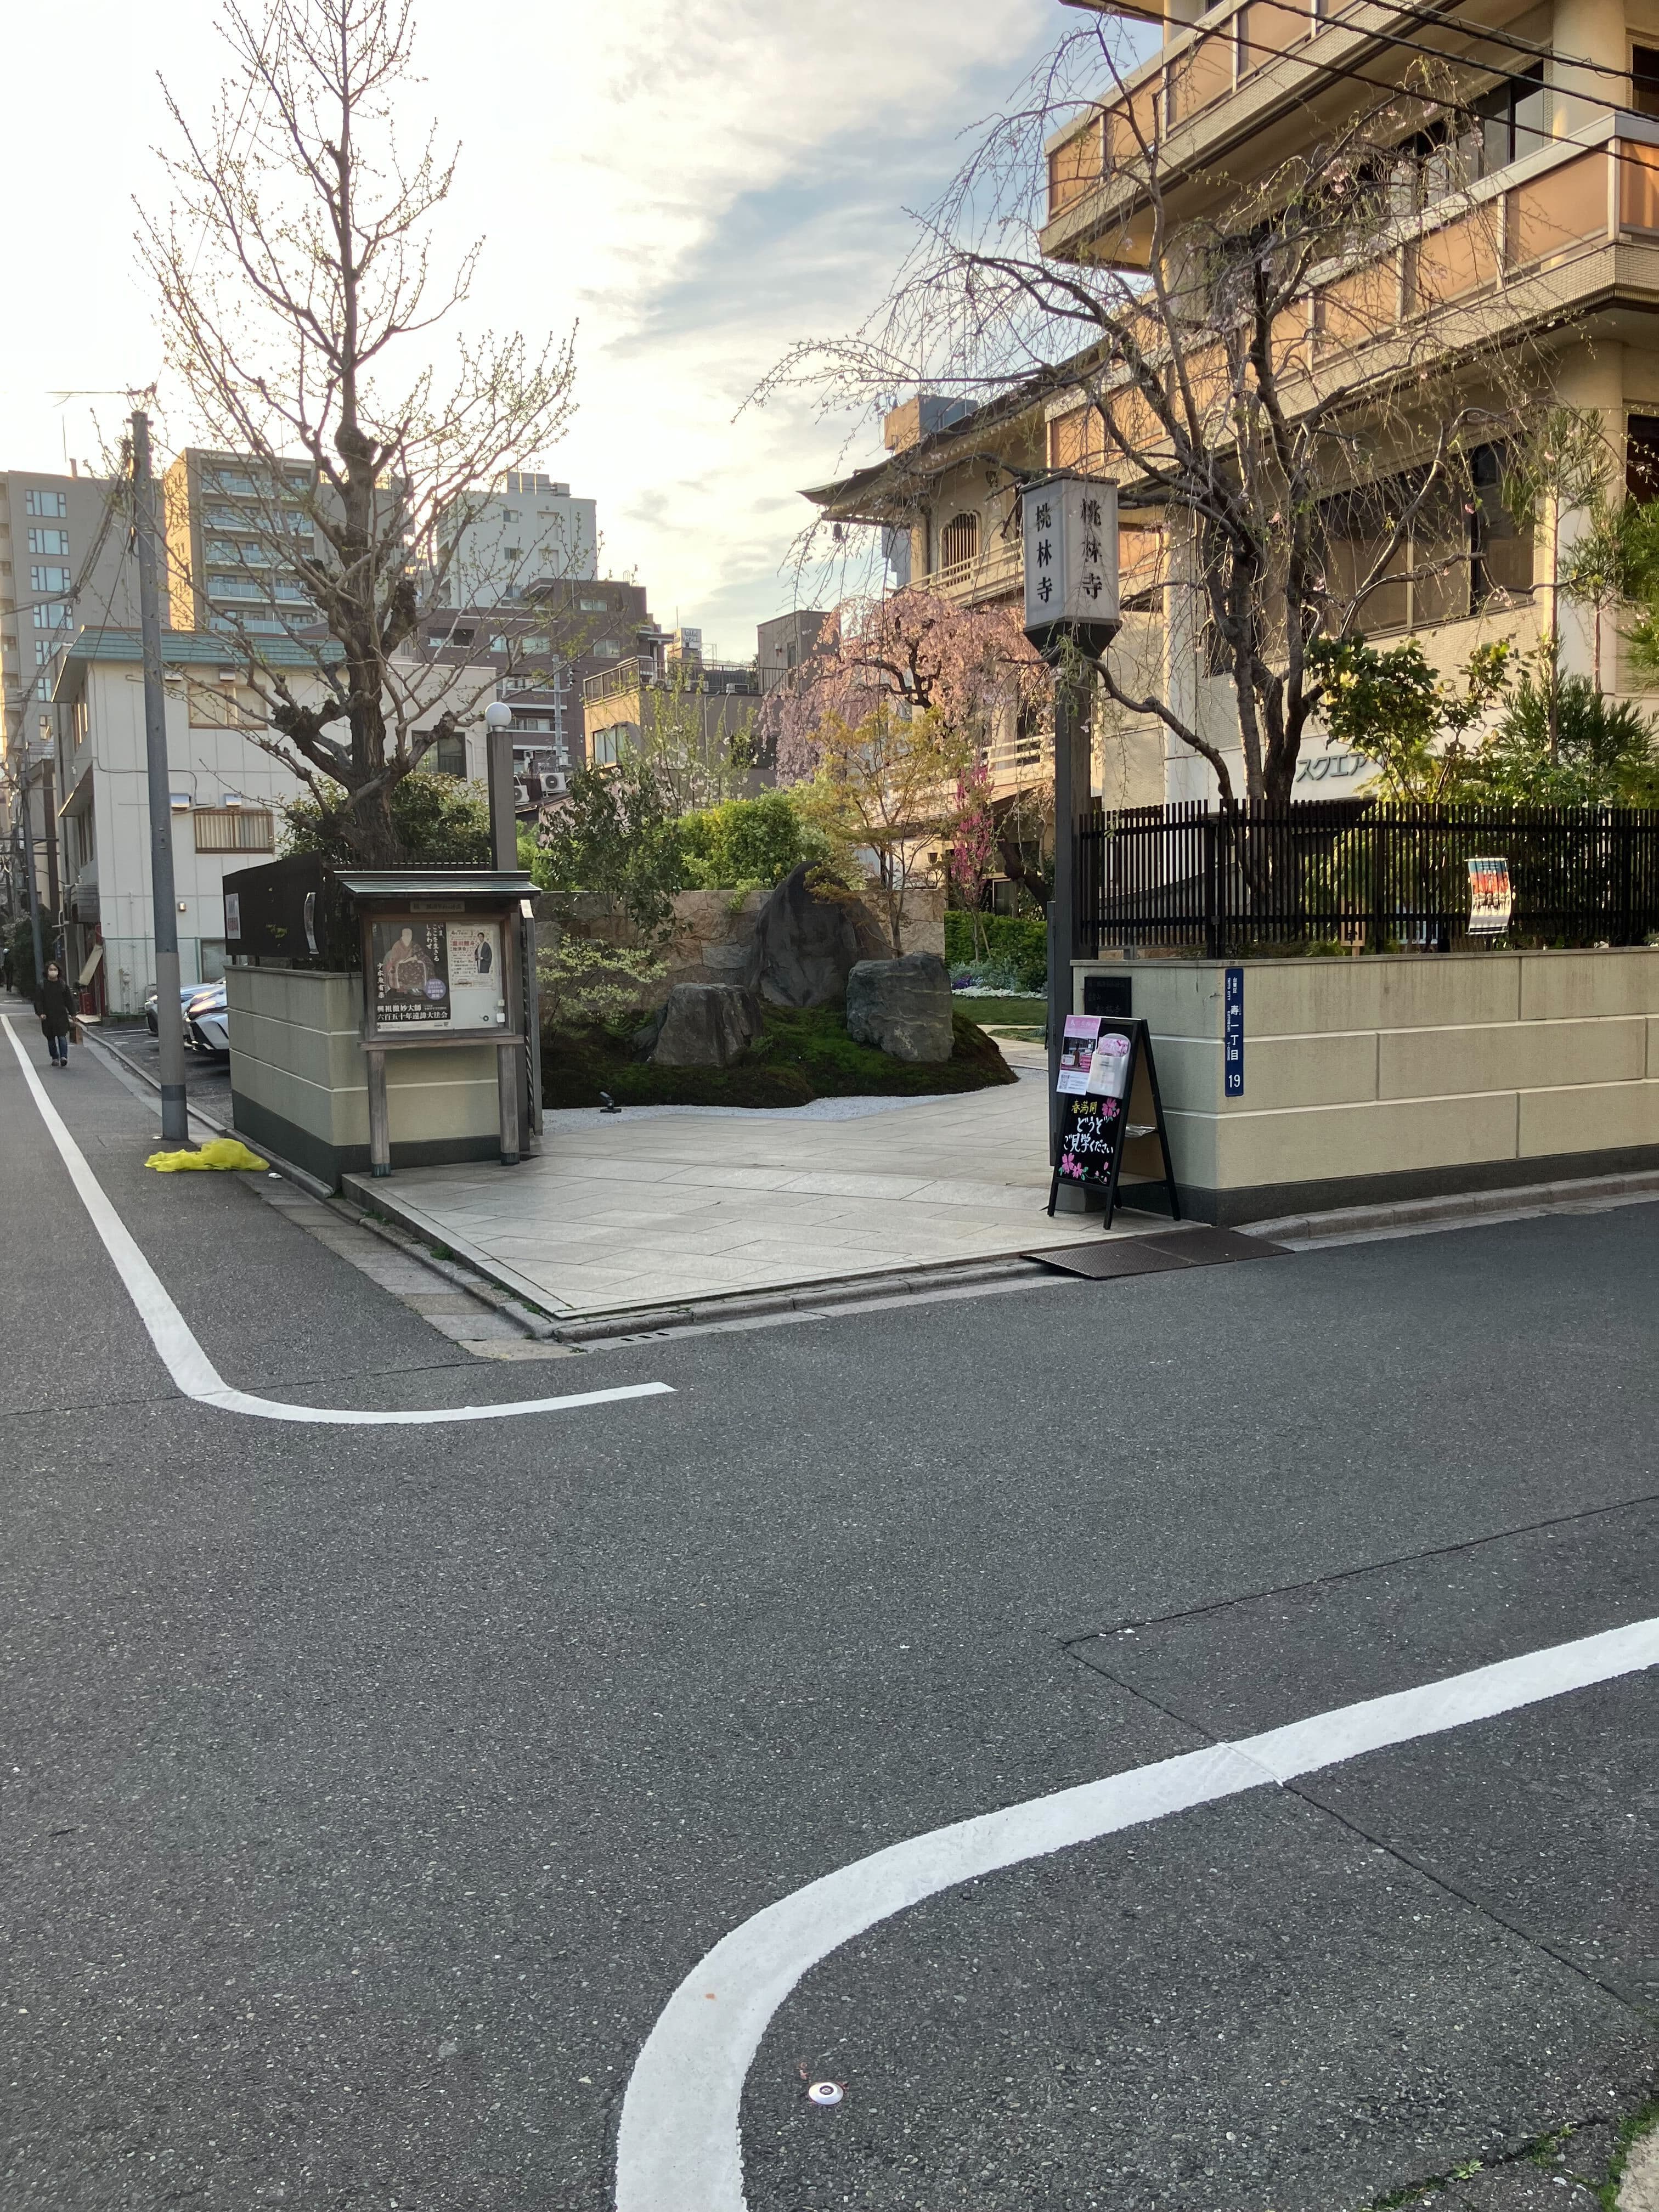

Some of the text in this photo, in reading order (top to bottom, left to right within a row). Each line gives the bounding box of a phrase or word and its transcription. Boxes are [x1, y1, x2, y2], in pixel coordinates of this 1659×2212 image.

[1036, 503, 1053, 603] 桃林寺
[1231, 1005, 1239, 1060] 寿一丁目
[1228, 1074, 1240, 1088] 19
[1071, 1099, 1097, 1115] 春満開
[1077, 1116, 1108, 1135] どうぞ
[1063, 1133, 1114, 1154] ご見学ください
